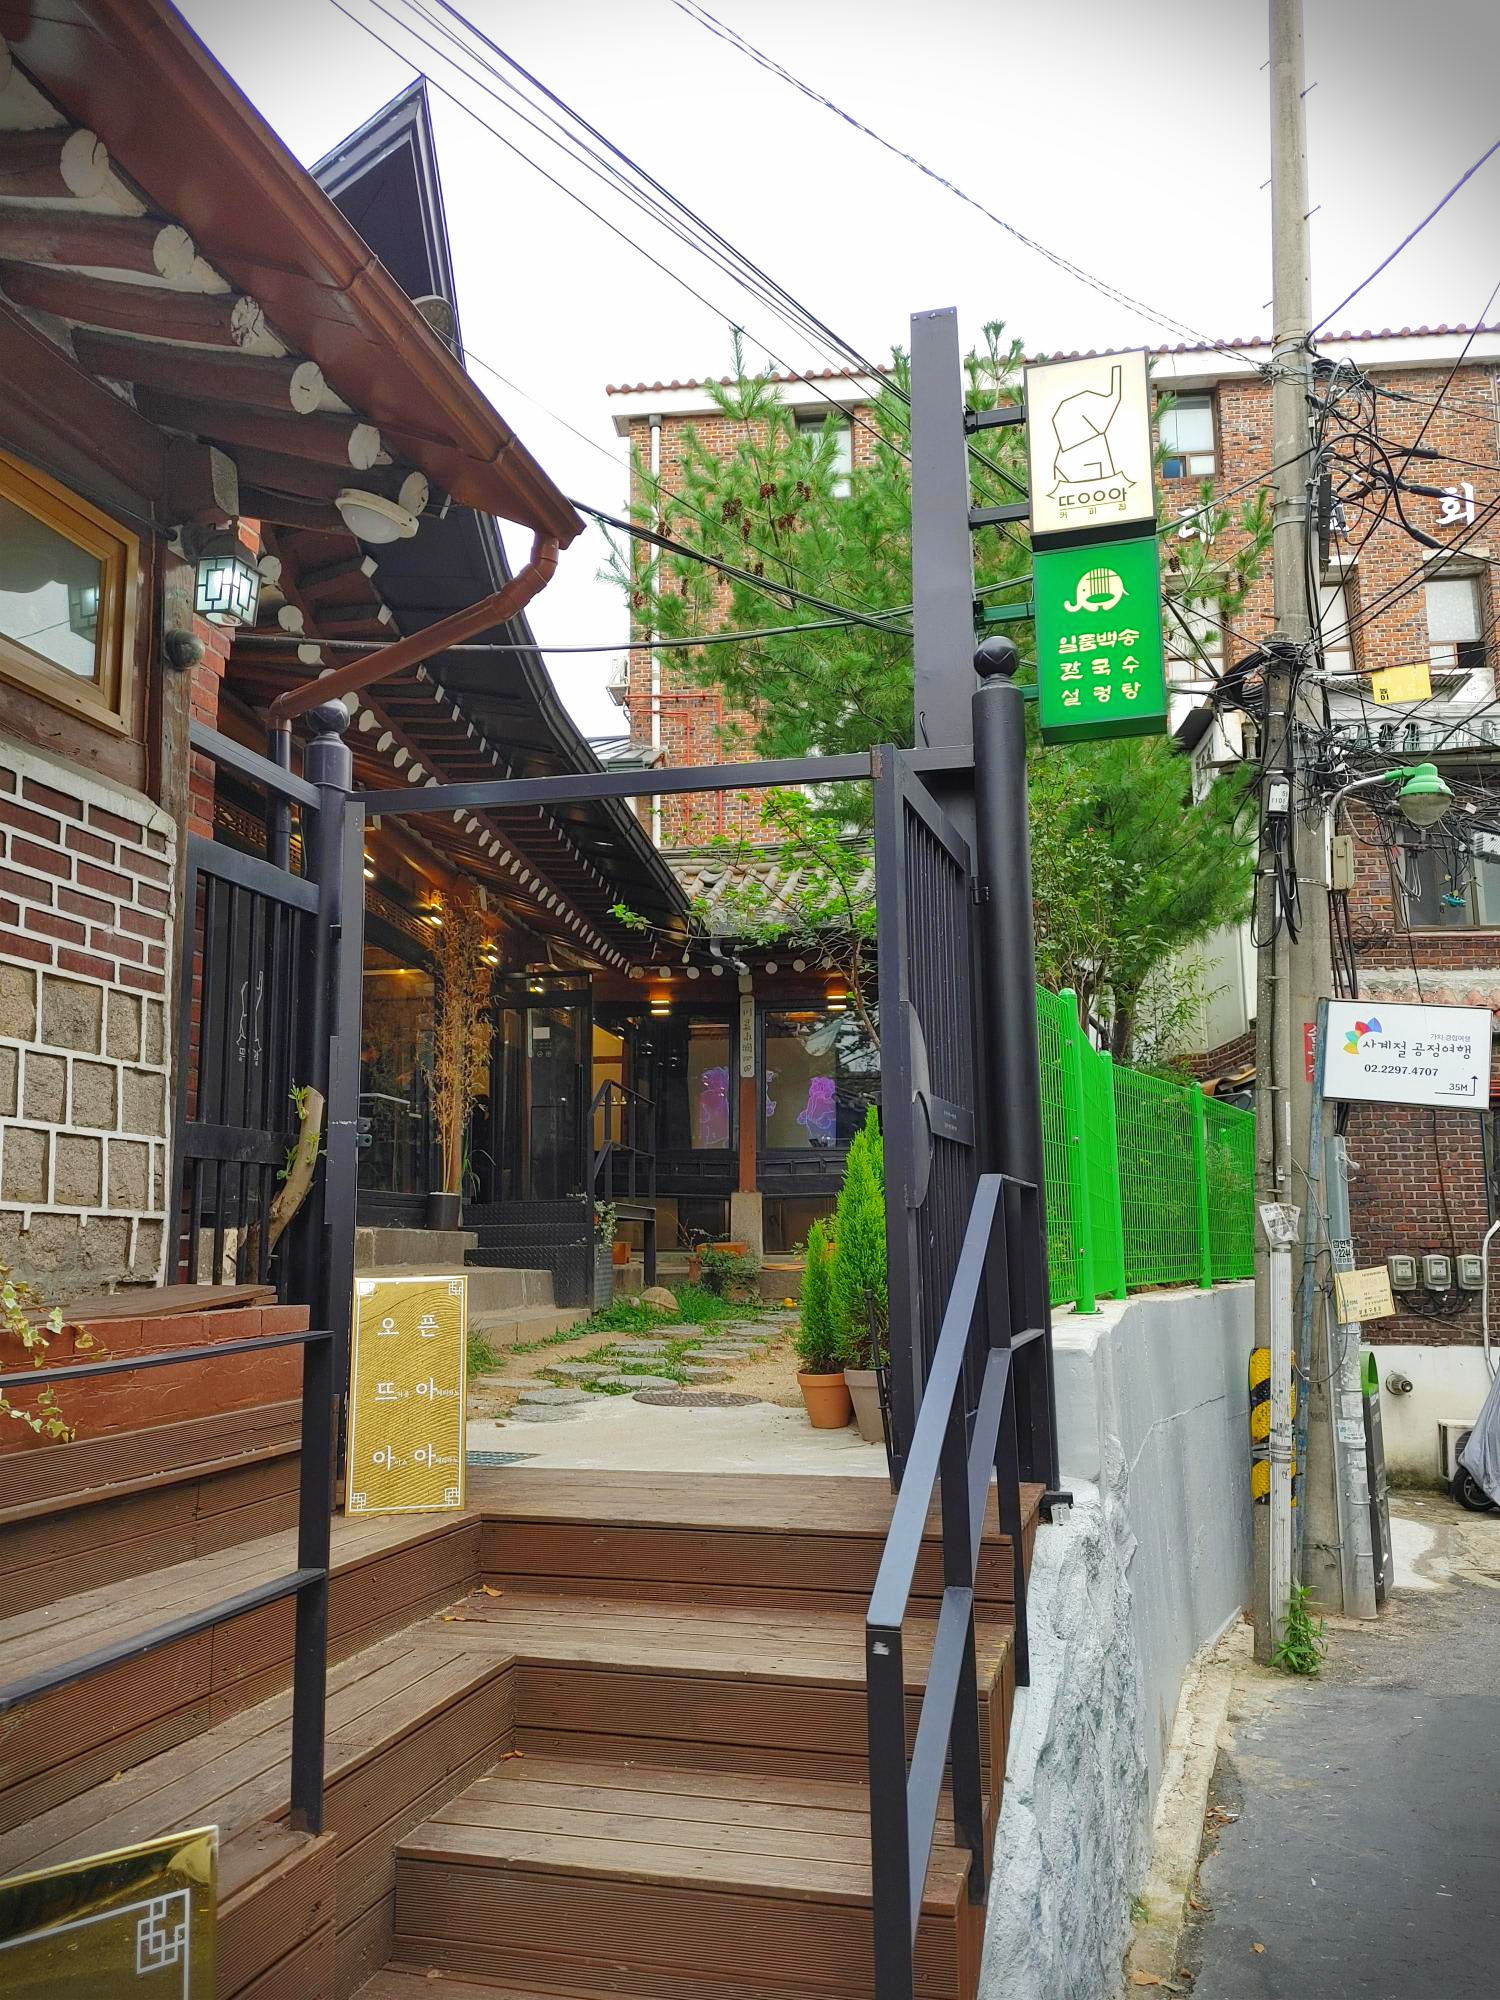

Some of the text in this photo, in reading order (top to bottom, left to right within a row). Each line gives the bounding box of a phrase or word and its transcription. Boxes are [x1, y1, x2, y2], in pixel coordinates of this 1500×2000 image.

[1058, 628, 1140, 654] 일품백송
[1060, 655, 1140, 681] 칼국수
[1061, 681, 1141, 707] 설렁탕
[1363, 1039, 1472, 1060] 사계절 공정여행
[1364, 1064, 1439, 1077] 02.2297.4707
[1448, 1083, 1468, 1092] 35M
